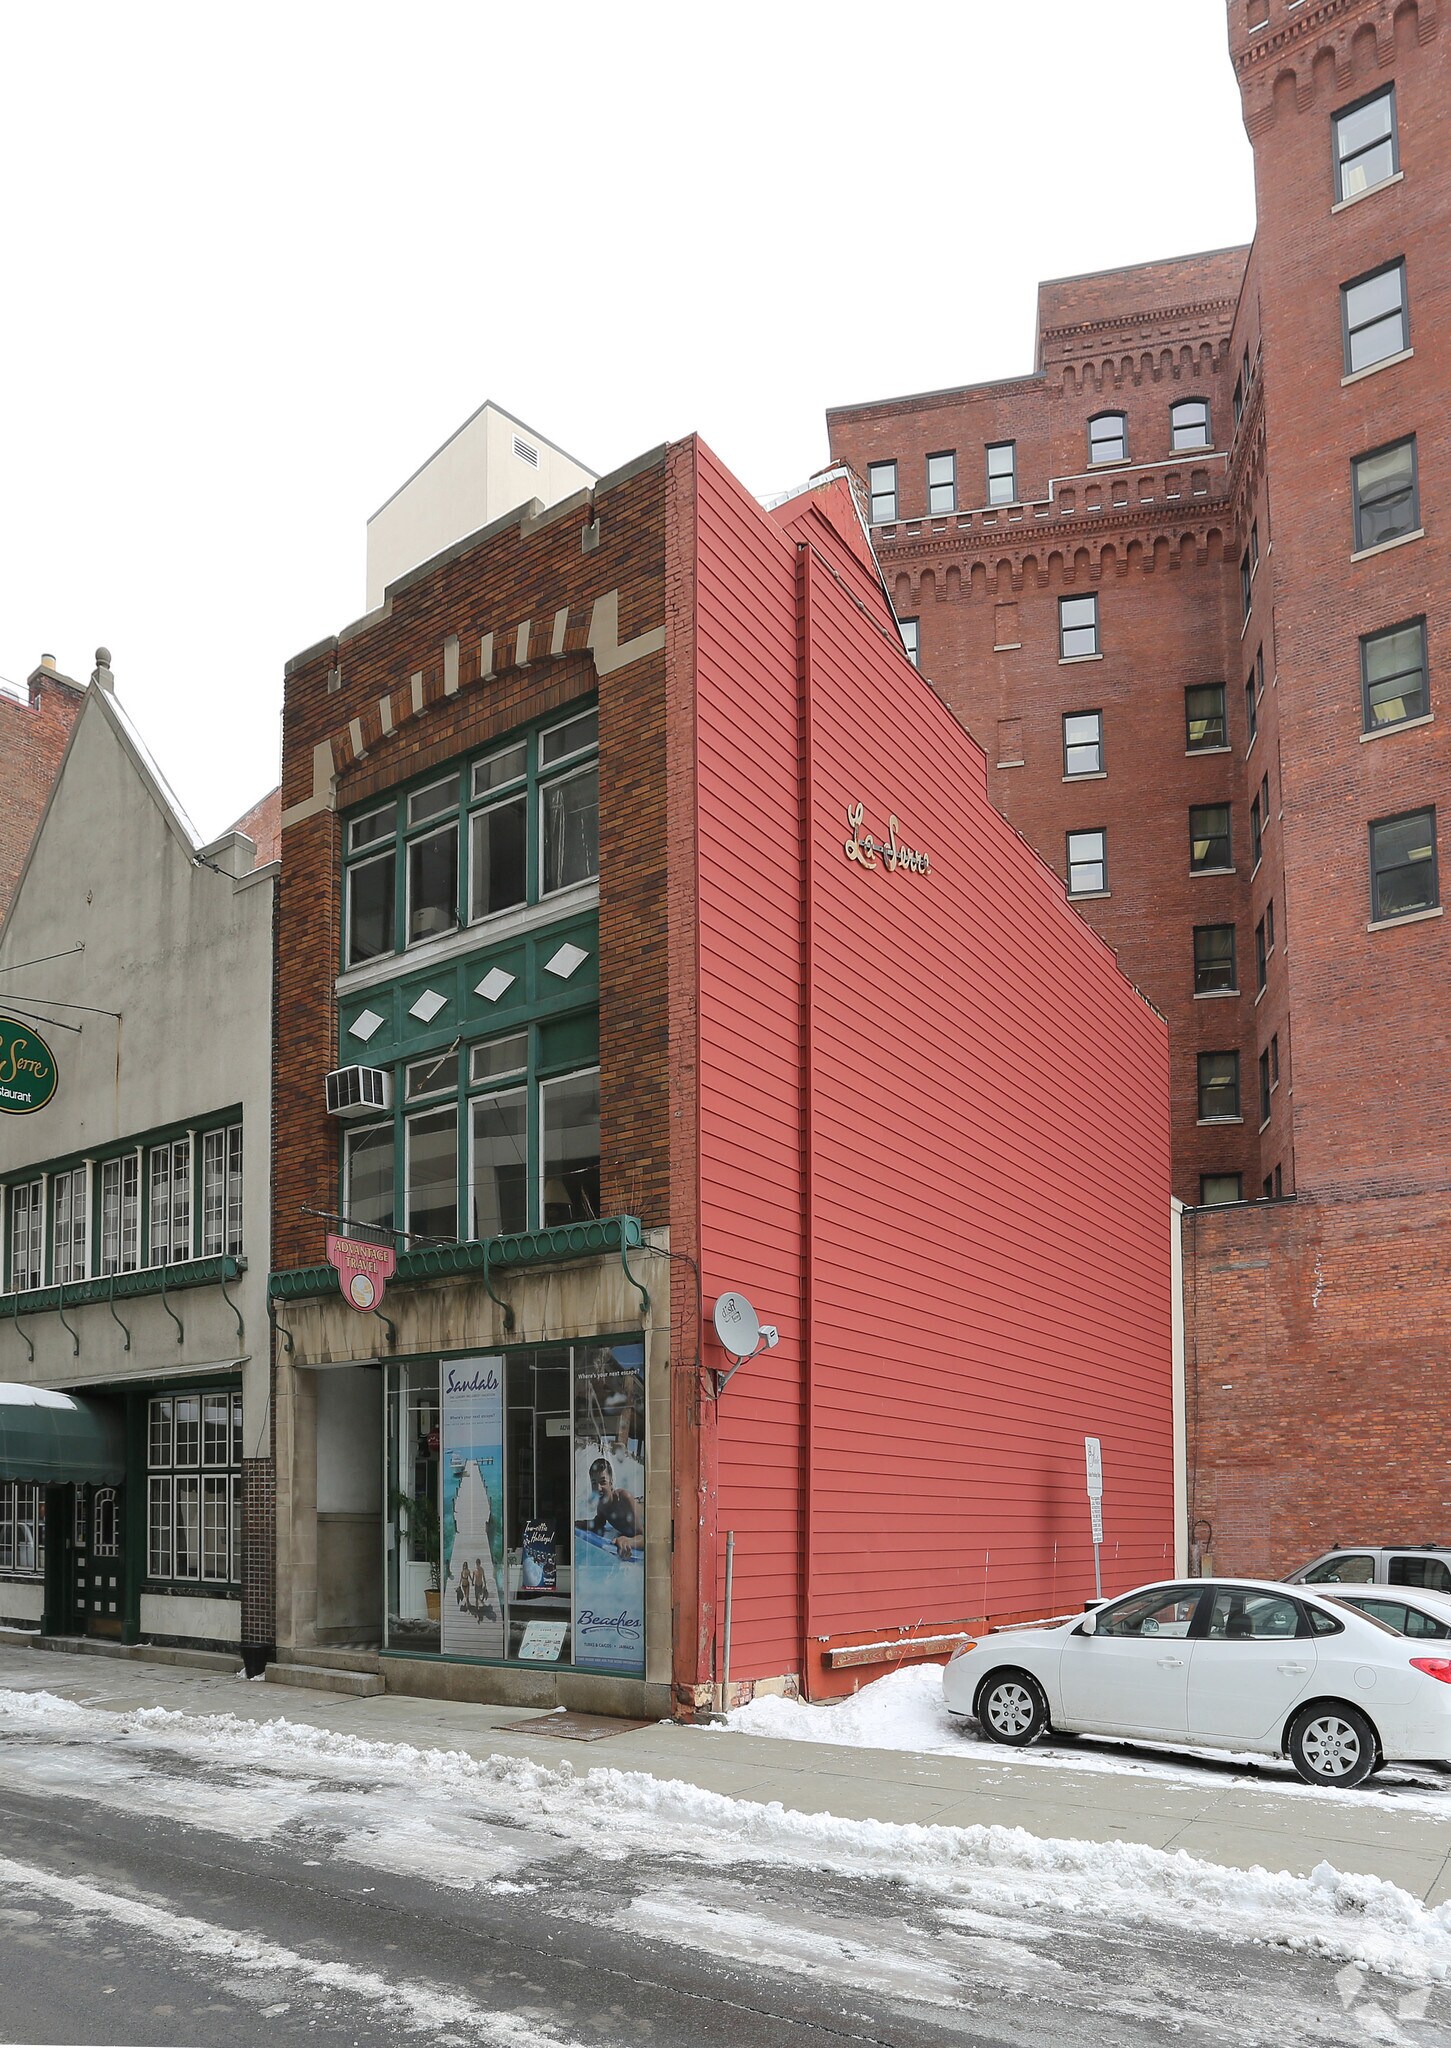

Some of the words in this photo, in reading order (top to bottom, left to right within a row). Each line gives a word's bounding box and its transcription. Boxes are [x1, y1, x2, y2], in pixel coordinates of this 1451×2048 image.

[845, 802, 877, 870] La
[883, 814, 932, 875] Serre
[0, 1039, 48, 1082] Serre
[334, 1240, 389, 1262] ADVANTAGE
[345, 1256, 379, 1274] TRAVEL
[446, 1369, 499, 1394] Sandals
[577, 1372, 596, 1380] Where's
[597, 1372, 608, 1380] your
[620, 1368, 640, 1376] escape?
